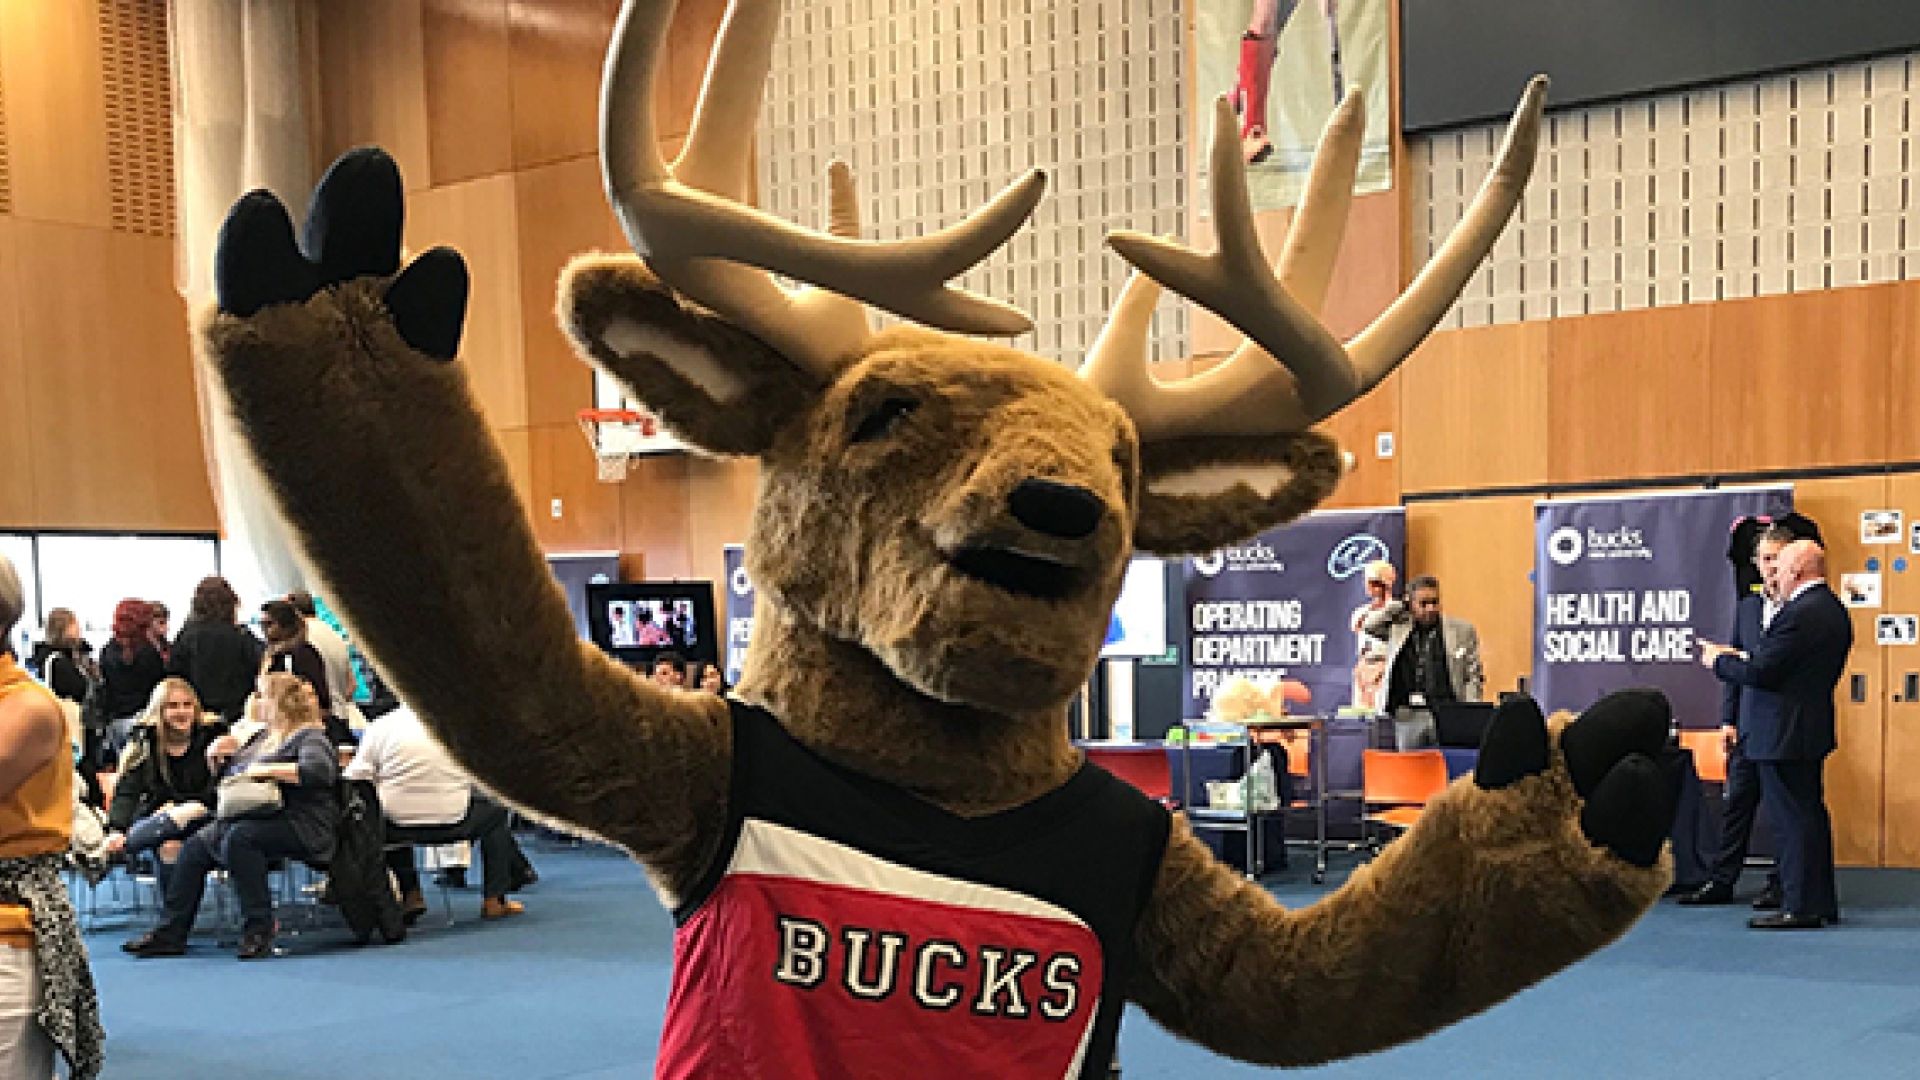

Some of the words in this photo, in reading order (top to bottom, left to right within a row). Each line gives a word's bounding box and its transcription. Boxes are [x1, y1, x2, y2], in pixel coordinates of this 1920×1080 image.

[1587, 526, 1642, 547] bucks
[1193, 601, 1302, 631] OPERATING
[1546, 592, 1635, 625] HEALTH
[1641, 590, 1690, 622] AND
[1192, 635, 1325, 664] DEPARTMENT
[1544, 631, 1625, 663] SOCIAL
[1632, 629, 1694, 661] CARE
[775, 916, 1082, 1020] BUCKS
